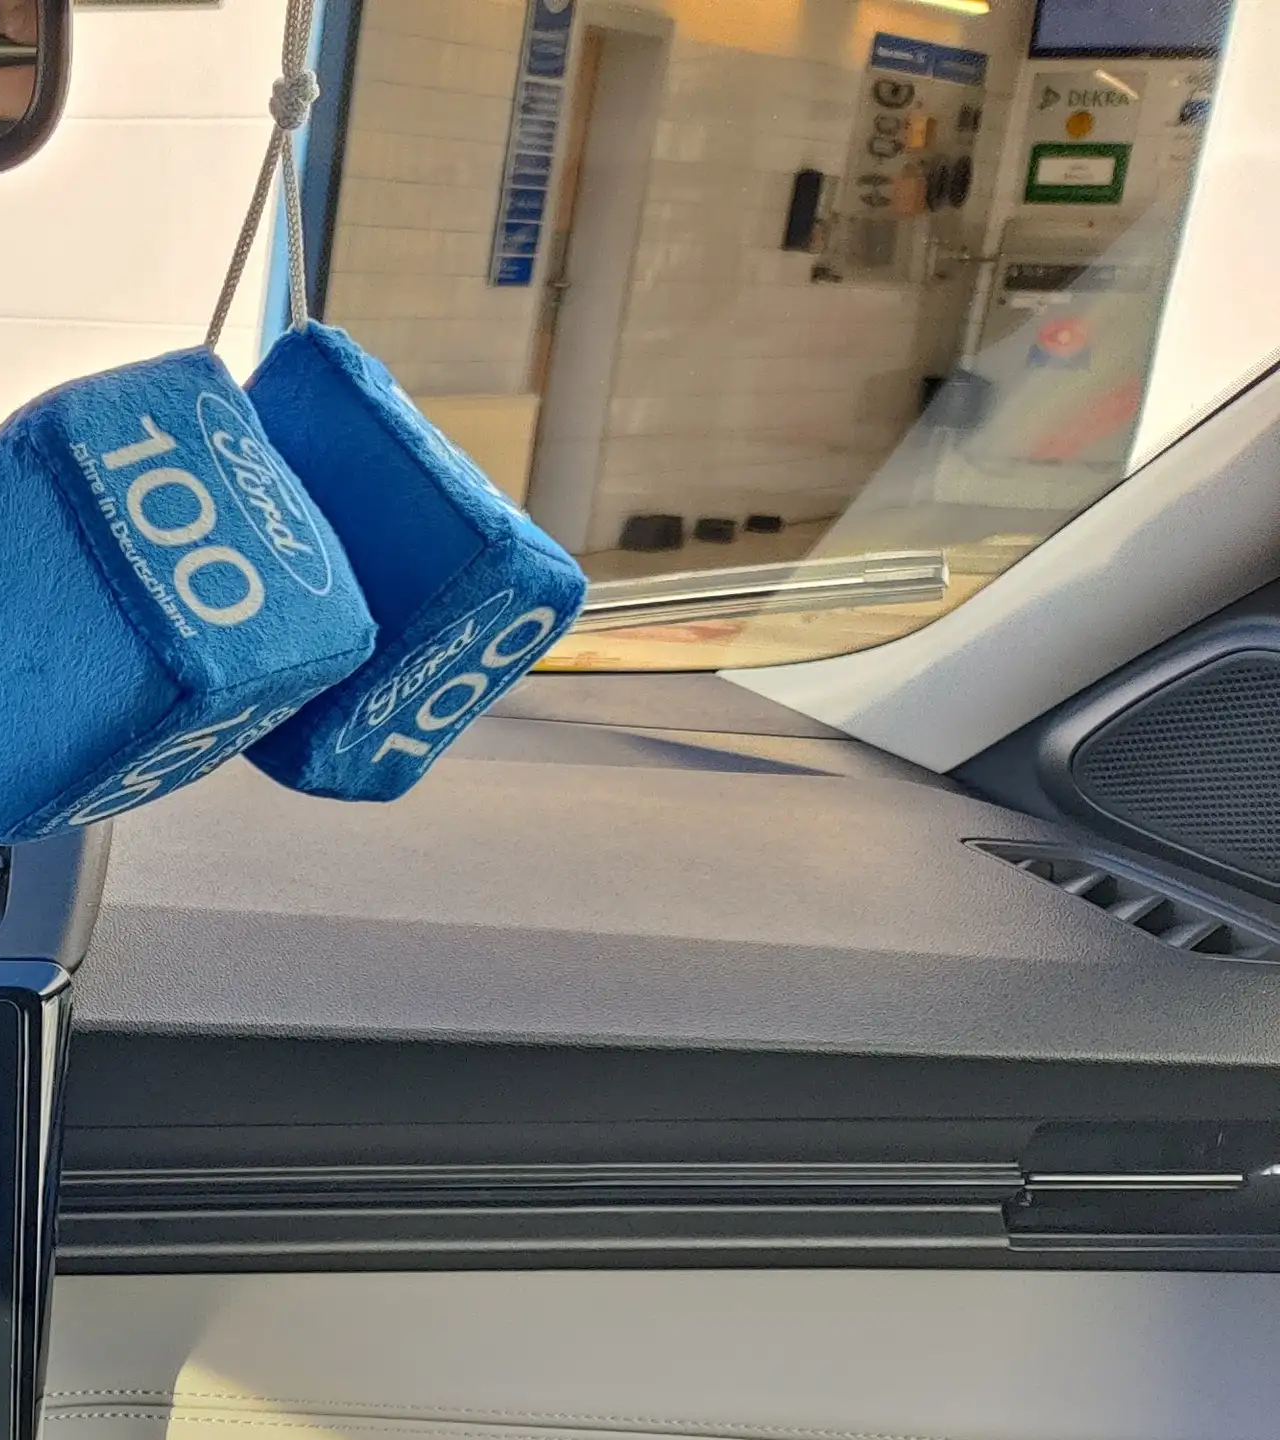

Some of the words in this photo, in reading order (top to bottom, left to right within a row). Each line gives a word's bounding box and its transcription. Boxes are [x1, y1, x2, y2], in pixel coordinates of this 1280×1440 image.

[100, 414, 267, 627] 100
[210, 429, 314, 557] Ford
[367, 619, 481, 726] Ford
[370, 606, 556, 765] 100
